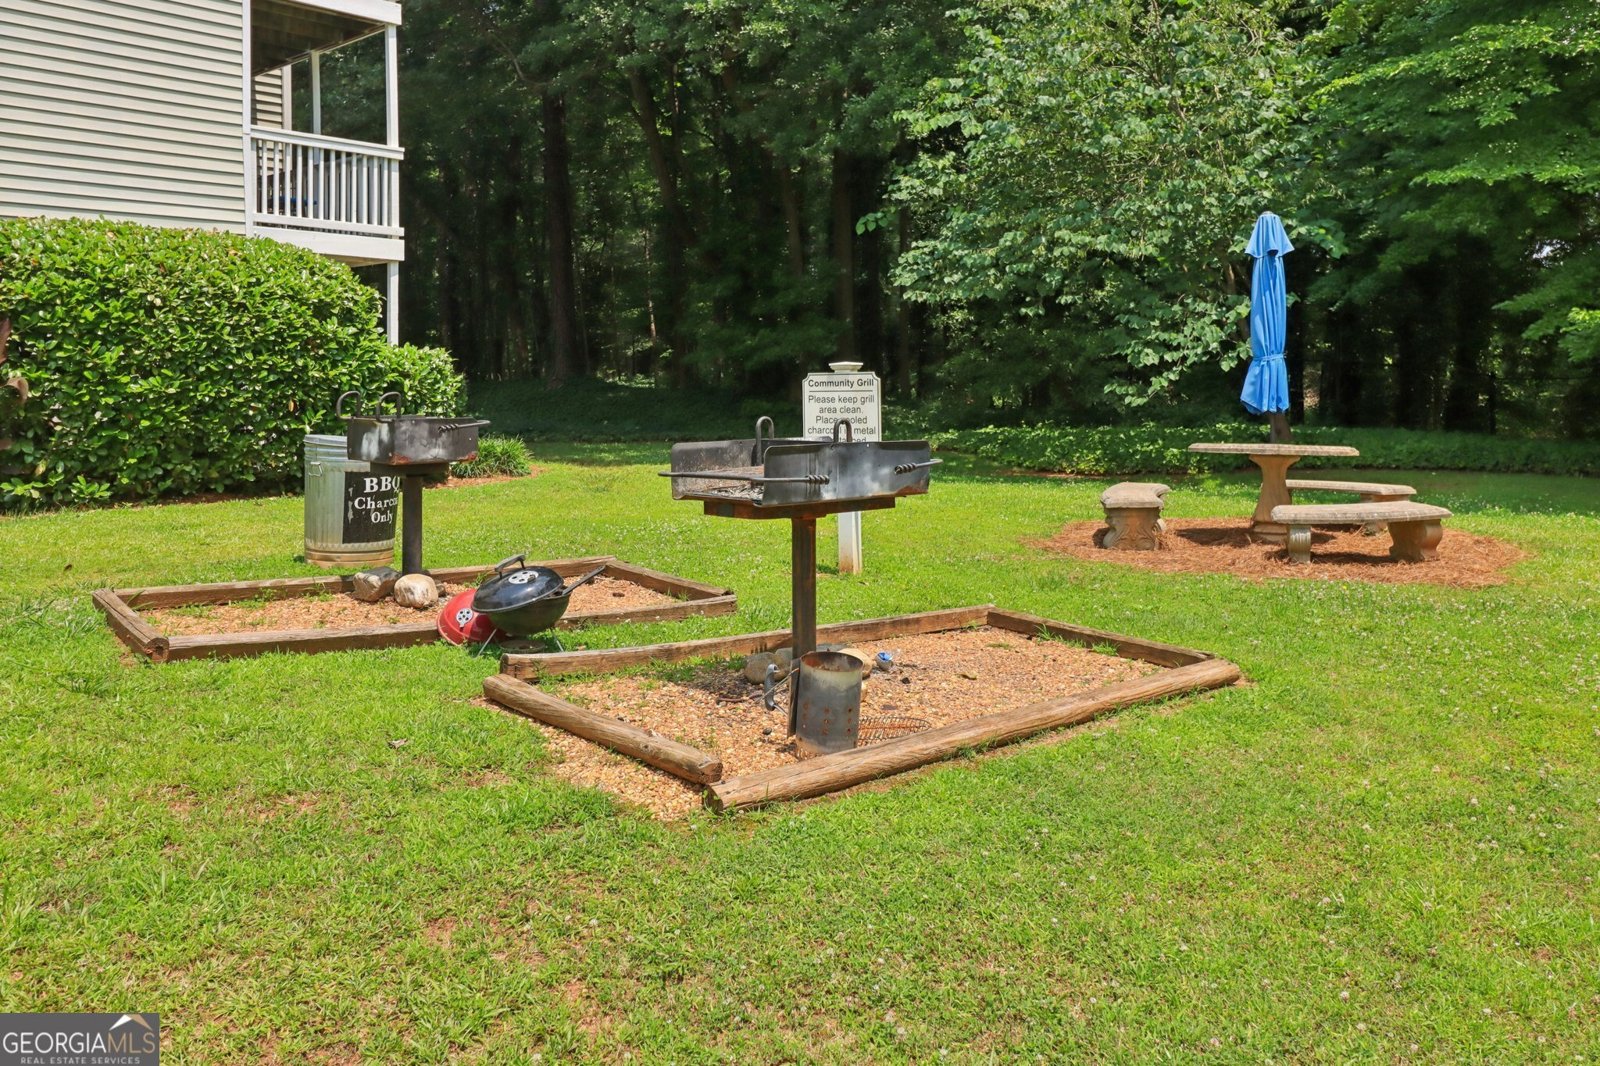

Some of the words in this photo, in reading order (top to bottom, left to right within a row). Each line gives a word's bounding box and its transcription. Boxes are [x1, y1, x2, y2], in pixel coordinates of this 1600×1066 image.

[808, 379, 854, 389] Community
[856, 378, 874, 387] Grill
[808, 395, 836, 404] Please
[838, 395, 858, 405] keep
[860, 394, 875, 405] grill
[819, 406, 837, 414] area
[839, 406, 864, 414] clean.
[815, 415, 839, 424] Place
[840, 416, 868, 424] oled
[807, 426, 843, 435] charcol
[853, 426, 876, 435] metal
[363, 476, 401, 493] BBQ
[371, 510, 393, 524] Only
